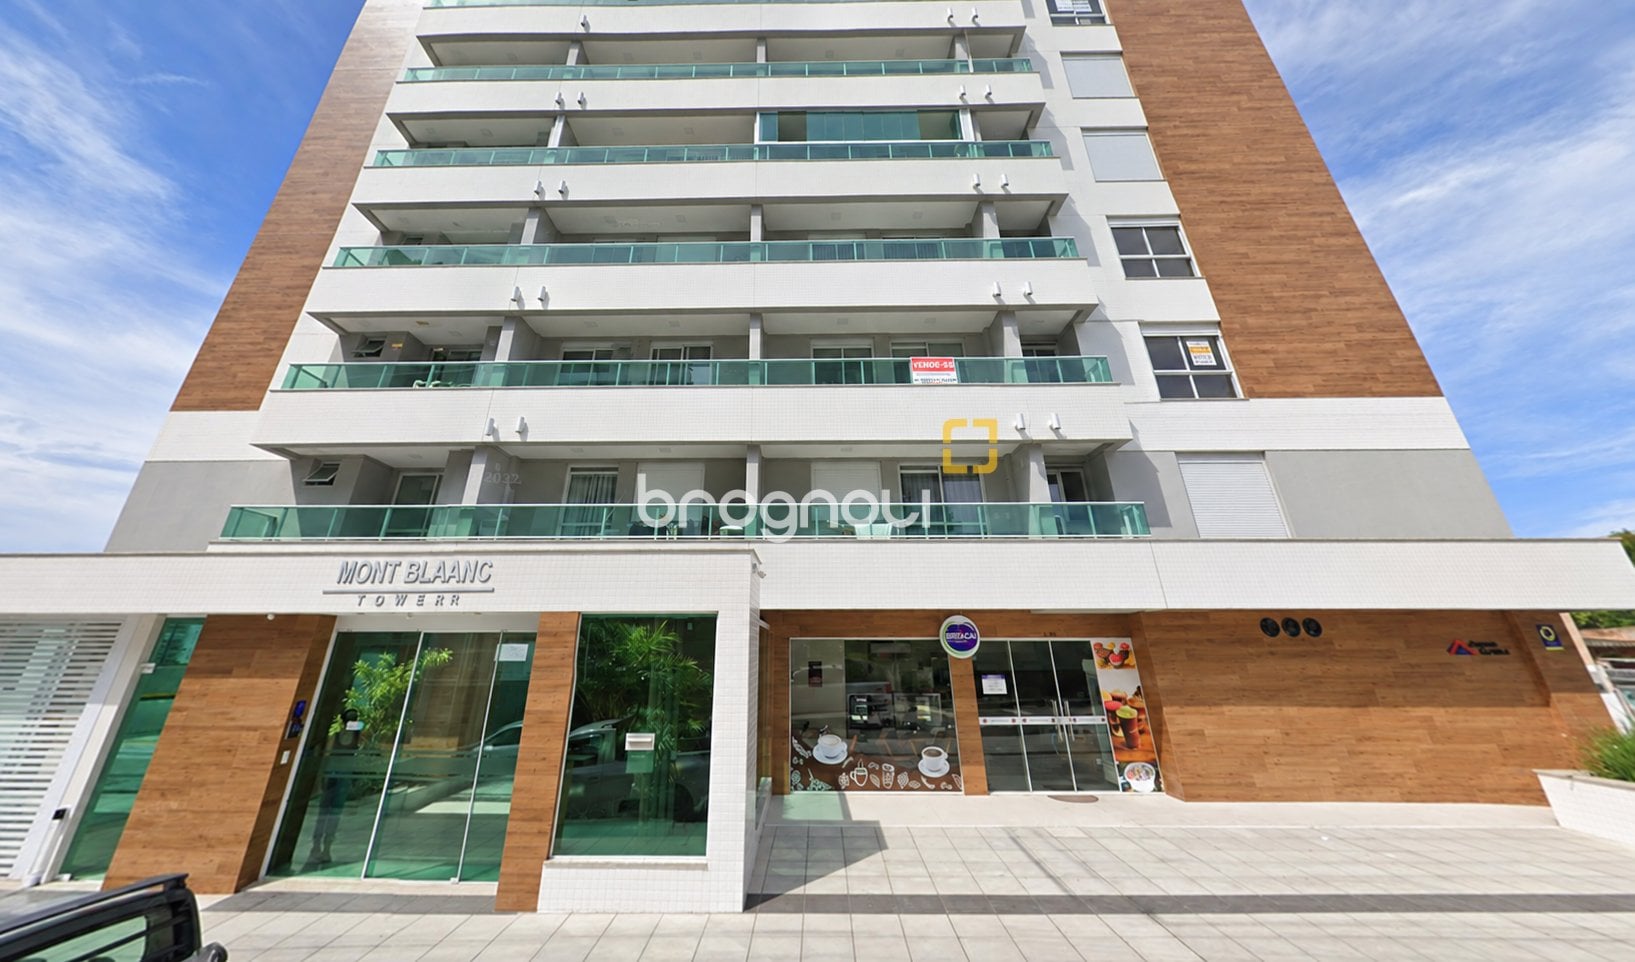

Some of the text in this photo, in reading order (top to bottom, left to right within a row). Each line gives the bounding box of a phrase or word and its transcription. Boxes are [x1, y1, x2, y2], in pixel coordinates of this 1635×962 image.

[336, 559, 493, 585] MONT BLAANC
[357, 594, 460, 607] TOWERR
